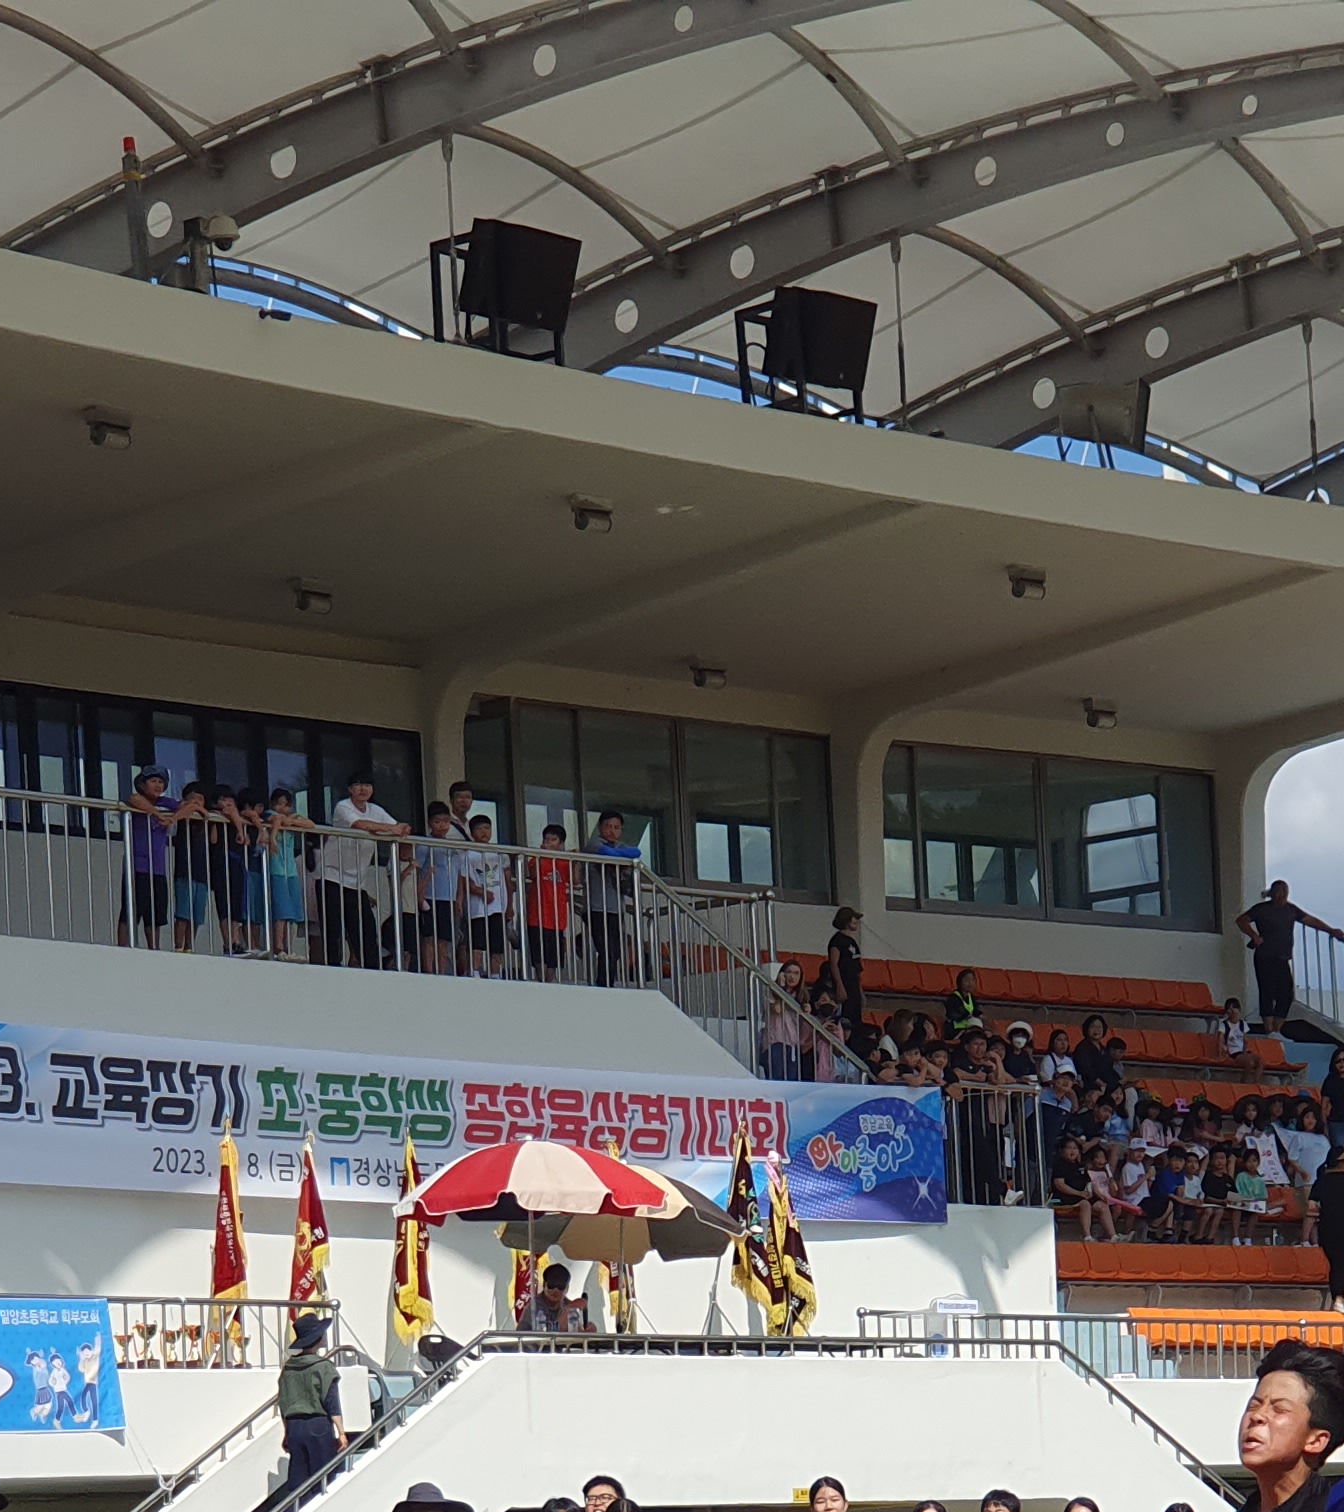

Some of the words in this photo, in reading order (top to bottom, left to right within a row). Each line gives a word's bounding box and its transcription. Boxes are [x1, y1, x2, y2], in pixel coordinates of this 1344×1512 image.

[49, 1052, 243, 1131] 교육장기
[256, 1066, 453, 1142] 초·중학생
[462, 1081, 787, 1159] 종합육상경기대회
[859, 1114, 894, 1135] 경남교육
[152, 1147, 212, 1178] 2023.
[0, 1308, 59, 1326] 밀양초등학교
[61, 1308, 100, 1326] 학부모회
